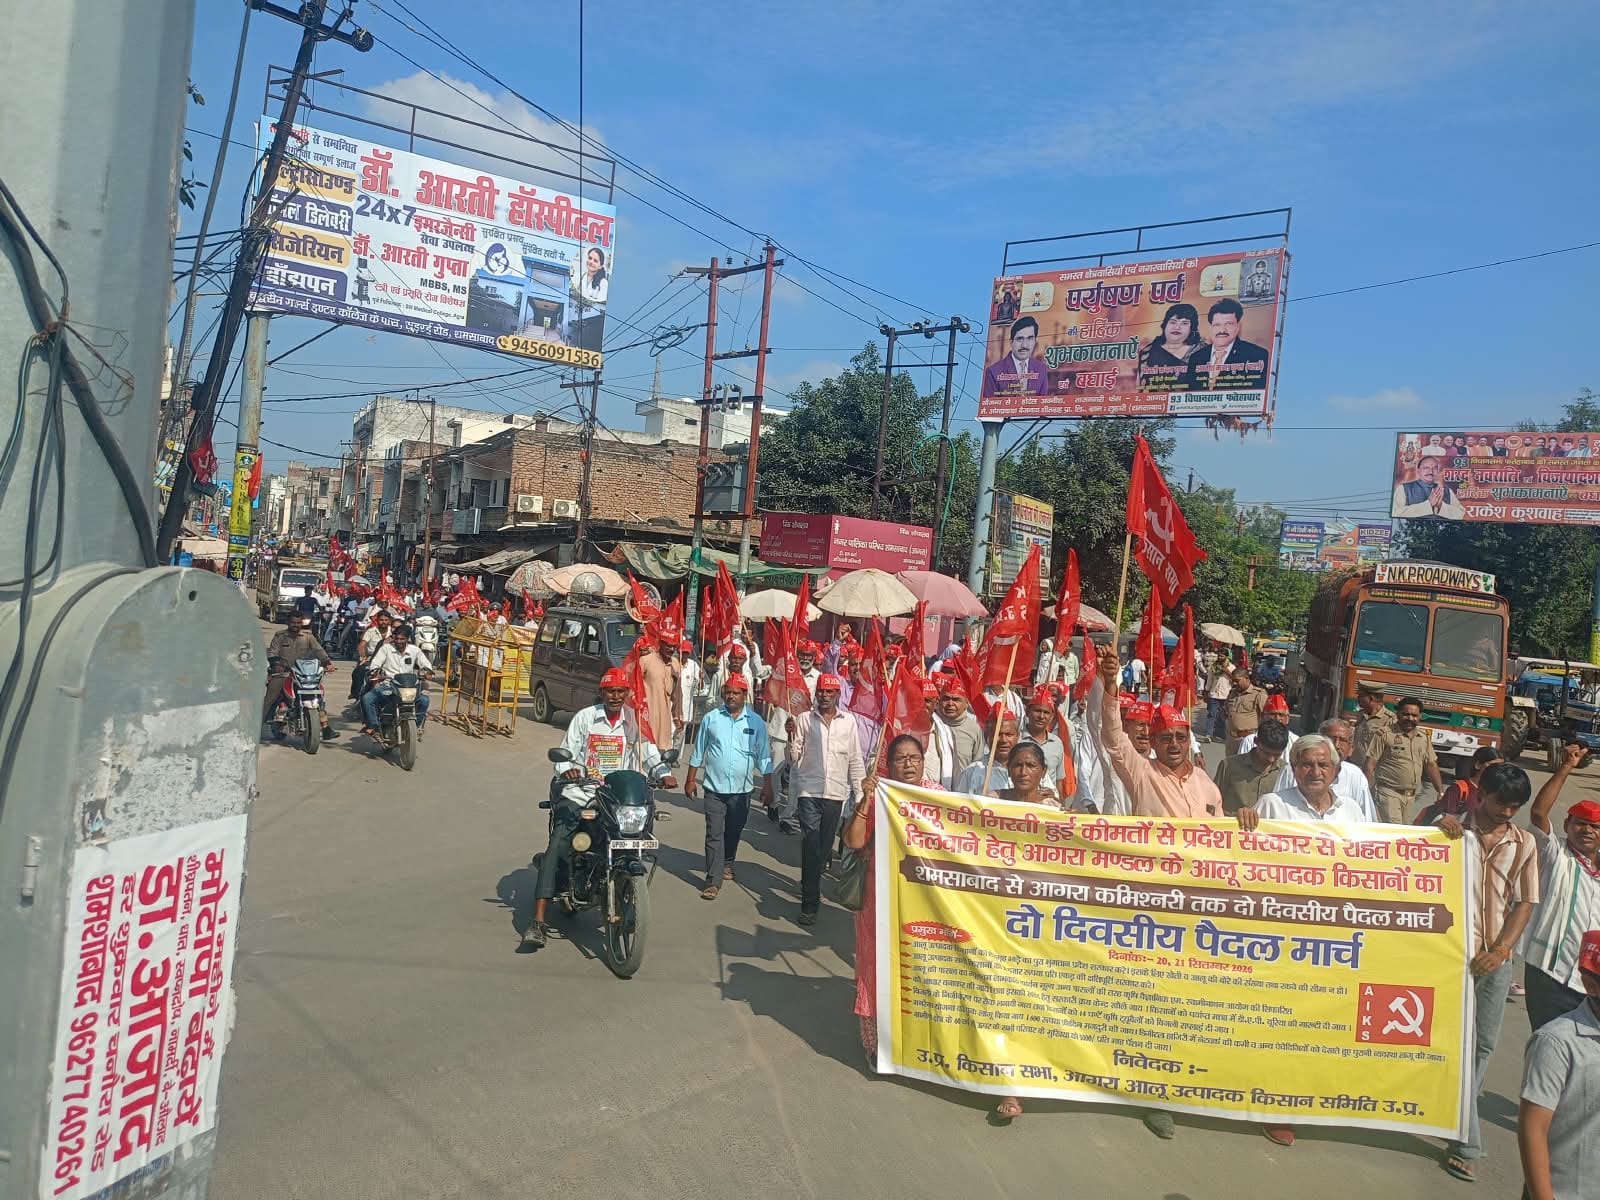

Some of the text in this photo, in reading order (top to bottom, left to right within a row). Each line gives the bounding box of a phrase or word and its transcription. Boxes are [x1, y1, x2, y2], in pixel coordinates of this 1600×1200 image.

[355, 194, 417, 226] 24x7
[416, 168, 500, 221] आरती
[506, 185, 615, 248] हॉस्पीटल
[420, 231, 439, 247] सेवा
[381, 242, 430, 270] आरती
[433, 254, 470, 279] गुप्ता
[420, 278, 467, 295] MBBS, MS
[424, 292, 438, 302] रोग
[1150, 274, 1187, 305] पर्व
[338, 306, 369, 323] कॉलेज
[1080, 318, 1121, 339] हार्दिक
[511, 337, 600, 367] 9456091536
[1076, 367, 1119, 390] बधाई
[1170, 394, 1182, 403] 93
[1465, 503, 1507, 520] राकेश
[1511, 506, 1563, 523] कुशवाह
[899, 801, 1451, 863] आलू की गिरती हुई कीमतों से प्रदेश सरकार से राहत पैकेज
[906, 822, 1443, 894] दिलवाने हेतु आगरा मण्डल के आलू उत्पादक किसानों का
[120, 872, 137, 915] हर
[915, 864, 1436, 930] शमसाबाद से आगरा कमिश्नरी तक दो दिवसीय पैदल मार्च
[1005, 903, 1365, 971] दो दिवसीय पैदल मार्च
[107, 921, 131, 1028] शुक्रवार
[1174, 957, 1186, 968] 21
[113, 857, 184, 1164] डा. आजाद
[53, 873, 116, 1196] शमशाबाद 9627740261
[1113, 1049, 1183, 1074] निवेदक
[916, 1049, 1426, 1117] उ.प्र. किसान सभा, आगरा आलू उत्पादक किसान समिति उ.प्र.
[91, 1124, 112, 1173] रोड
